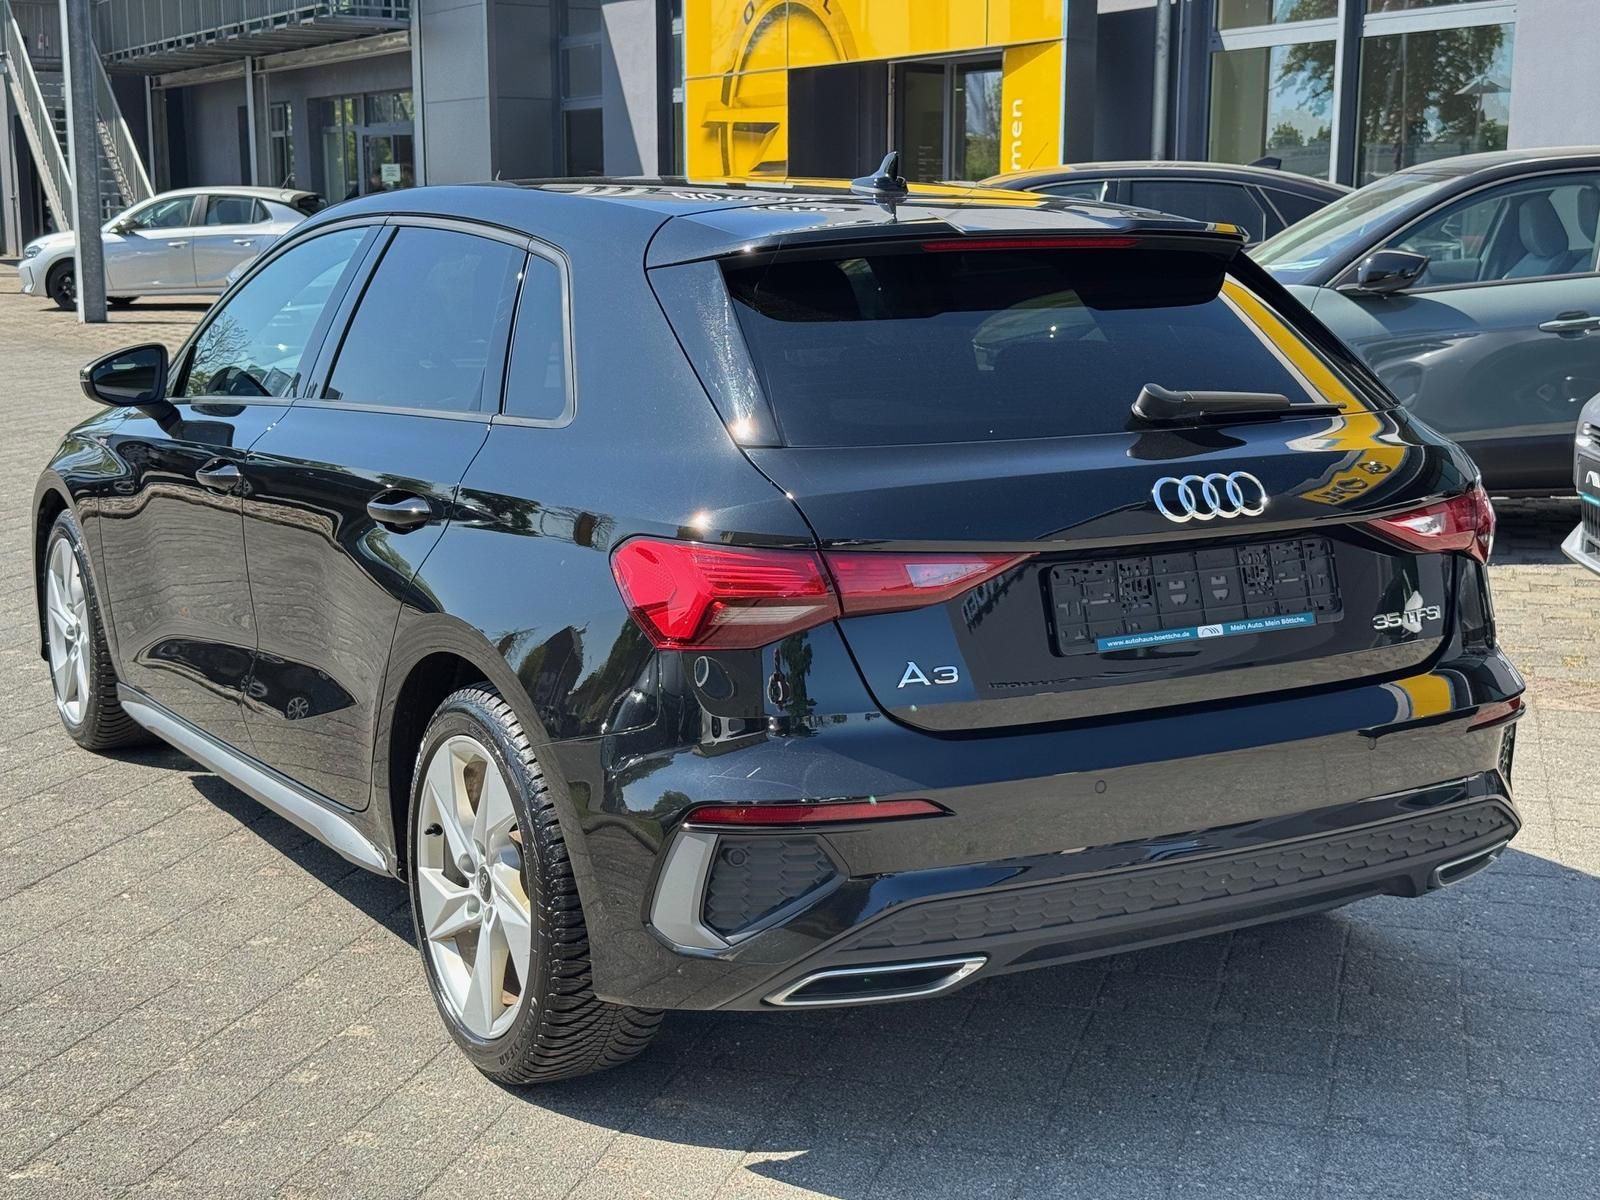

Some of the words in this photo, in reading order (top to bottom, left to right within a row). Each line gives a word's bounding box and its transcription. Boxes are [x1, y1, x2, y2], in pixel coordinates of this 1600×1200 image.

[1230, 623, 1246, 631] Mein
[1247, 621, 1264, 629] Auto.
[1265, 619, 1281, 627] Mein
[1372, 612, 1402, 630] 35
[1403, 604, 1441, 625] TFSI
[1106, 631, 1190, 647] www.autohaus-boettche.de
[897, 661, 959, 689] A3
